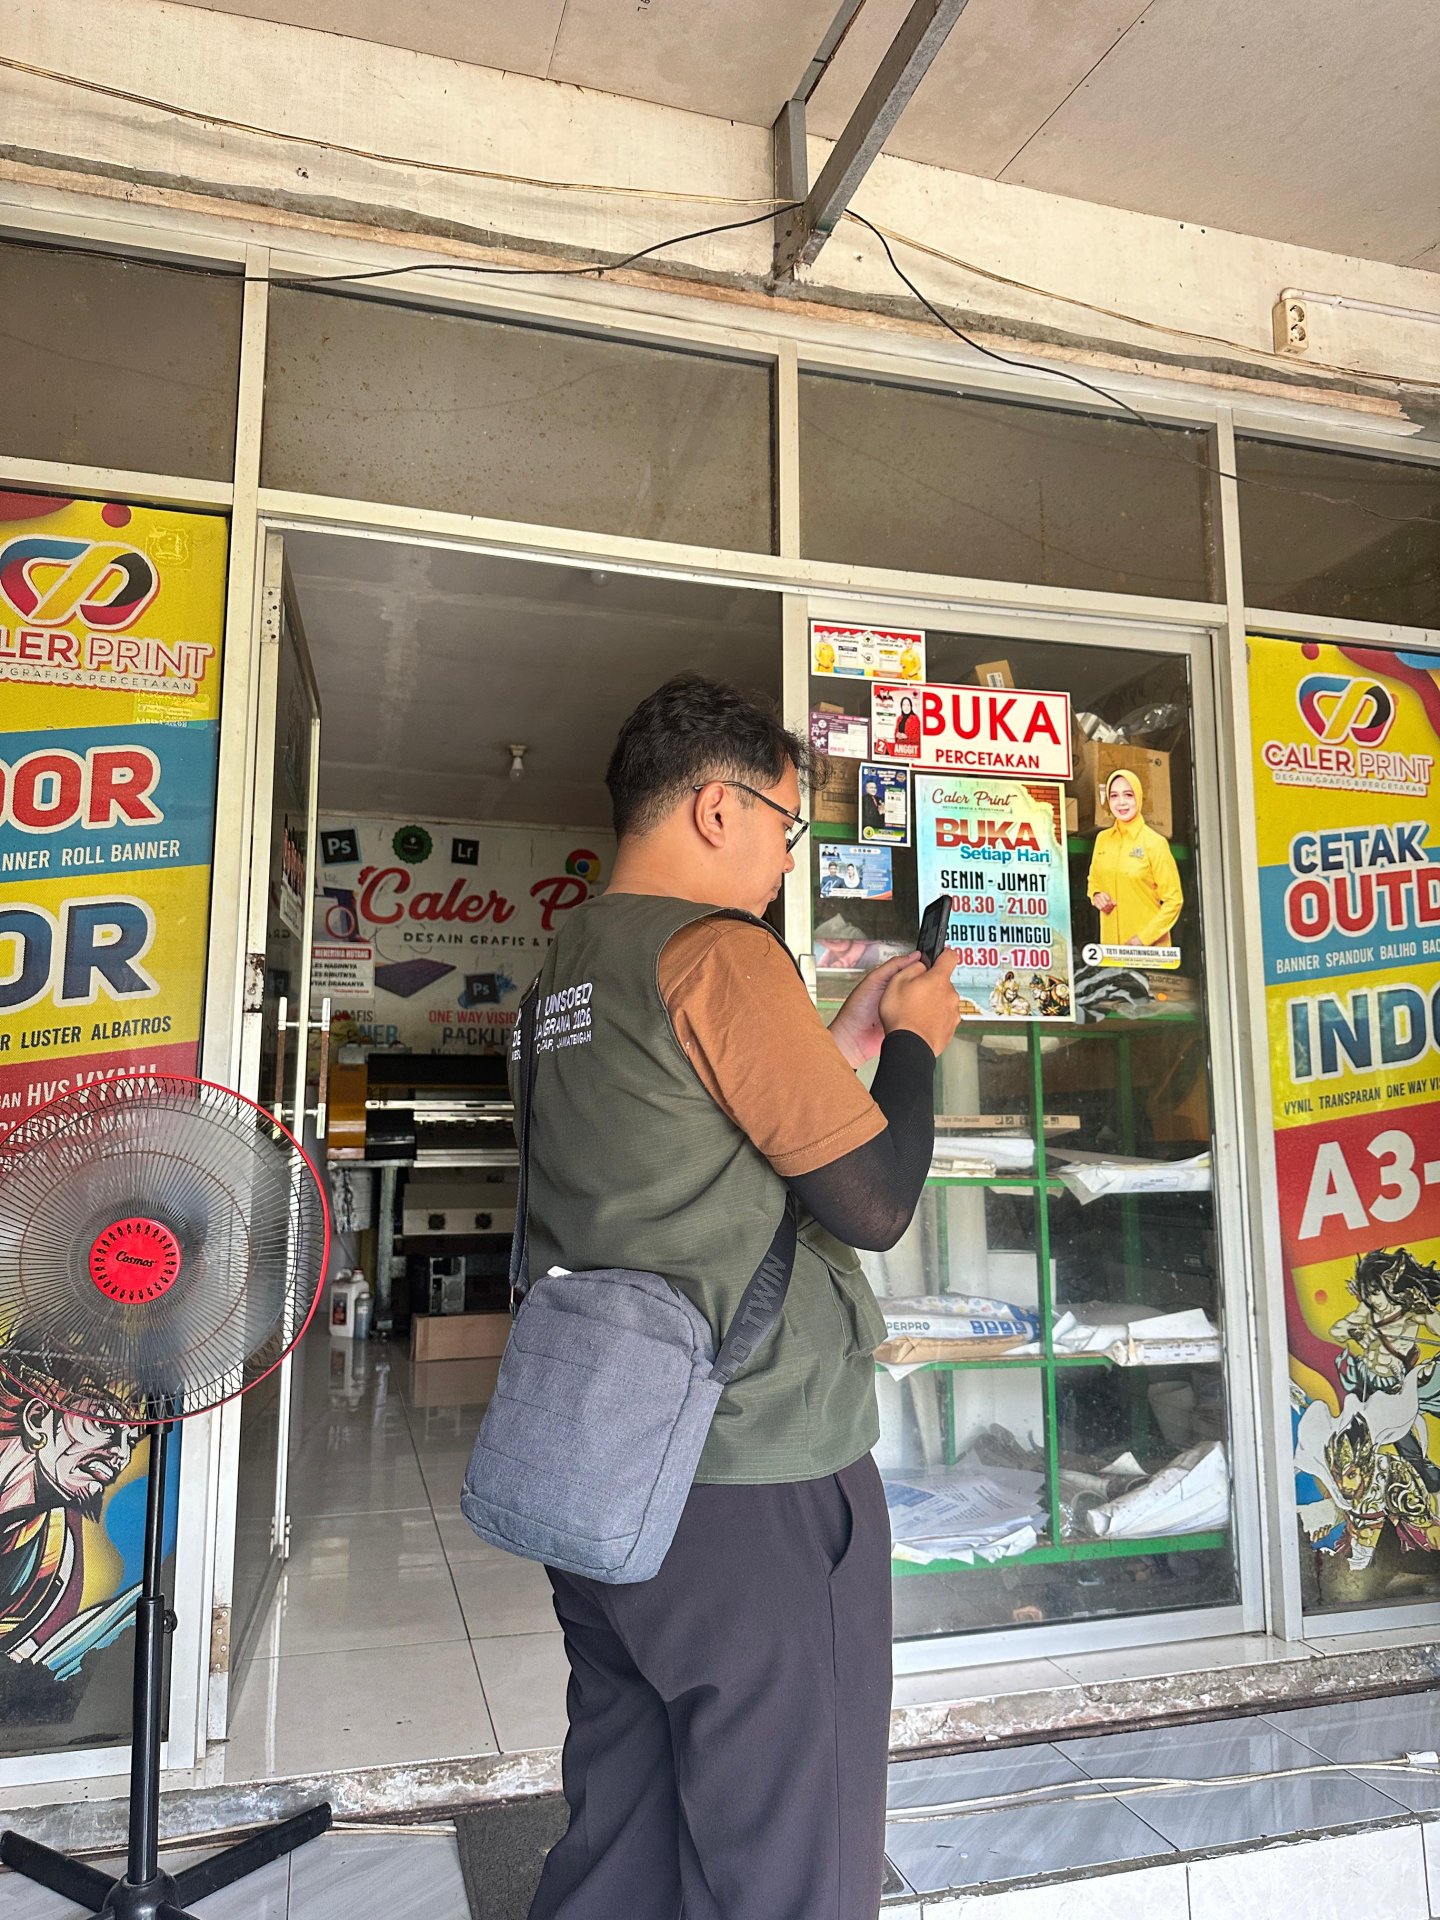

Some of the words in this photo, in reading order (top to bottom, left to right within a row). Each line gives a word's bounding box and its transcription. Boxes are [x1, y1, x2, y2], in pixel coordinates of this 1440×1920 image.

[89, 637, 208, 674] PRINT
[11, 667, 69, 681] GRAFIS
[75, 674, 82, 682] &
[89, 674, 192, 690] PERCETAKAN
[922, 691, 1061, 745] BUKA
[894, 743, 918, 755] ANGGIT
[936, 748, 1040, 769] PERCETAKAN
[1264, 743, 1351, 773] CALER
[1360, 752, 1430, 781] PRINT
[0, 750, 156, 828] OR
[1275, 773, 1312, 783] DESAIN
[1315, 776, 1351, 787] GRAFIS
[1361, 781, 1424, 793] PERCETAKAN
[932, 788, 970, 804] Caler
[973, 790, 1017, 807] Print
[935, 817, 1041, 851] BUKA
[61, 846, 105, 866] ROLL
[111, 839, 181, 862] BANNER
[327, 838, 351, 856] Ps
[457, 841, 474, 858] Lr
[960, 846, 1012, 864] Setiap
[1017, 848, 1050, 863] Hari
[1293, 824, 1424, 874] CETAK
[941, 870, 984, 890] SENIN
[997, 873, 1047, 892] JUMAT
[358, 866, 516, 925] Caler
[951, 895, 995, 914] 08.30
[1007, 897, 1047, 915] 21.00
[404, 932, 463, 943] DESAIN
[470, 935, 525, 946] GRAFIS
[533, 938, 539, 946] &
[989, 927, 997, 942] &
[1000, 926, 1051, 944] MINGGU
[1011, 948, 1050, 967] 17.00
[1088, 948, 1098, 960] 2
[1276, 954, 1320, 974] BANNER
[1325, 947, 1374, 967] SPANDUK
[1380, 942, 1417, 960] BALIHO
[473, 982, 490, 995] Ps
[545, 983, 593, 1016] UNSOED
[429, 1010, 453, 1023] ONE
[457, 1011, 483, 1024] WAY
[572, 1007, 592, 1030] 2026
[21, 1026, 81, 1048] LUSTER
[91, 1015, 171, 1041] ALBATROS
[27, 1080, 70, 1107] HVS
[1284, 1098, 1313, 1115] VYNIL
[1318, 1087, 1381, 1110] TRANSPARAN
[1387, 1083, 1405, 1098] ONE
[1407, 1078, 1428, 1094] WAY
[116, 1250, 155, 1268] Cosmos
[740, 1252, 787, 1334] TWIN
